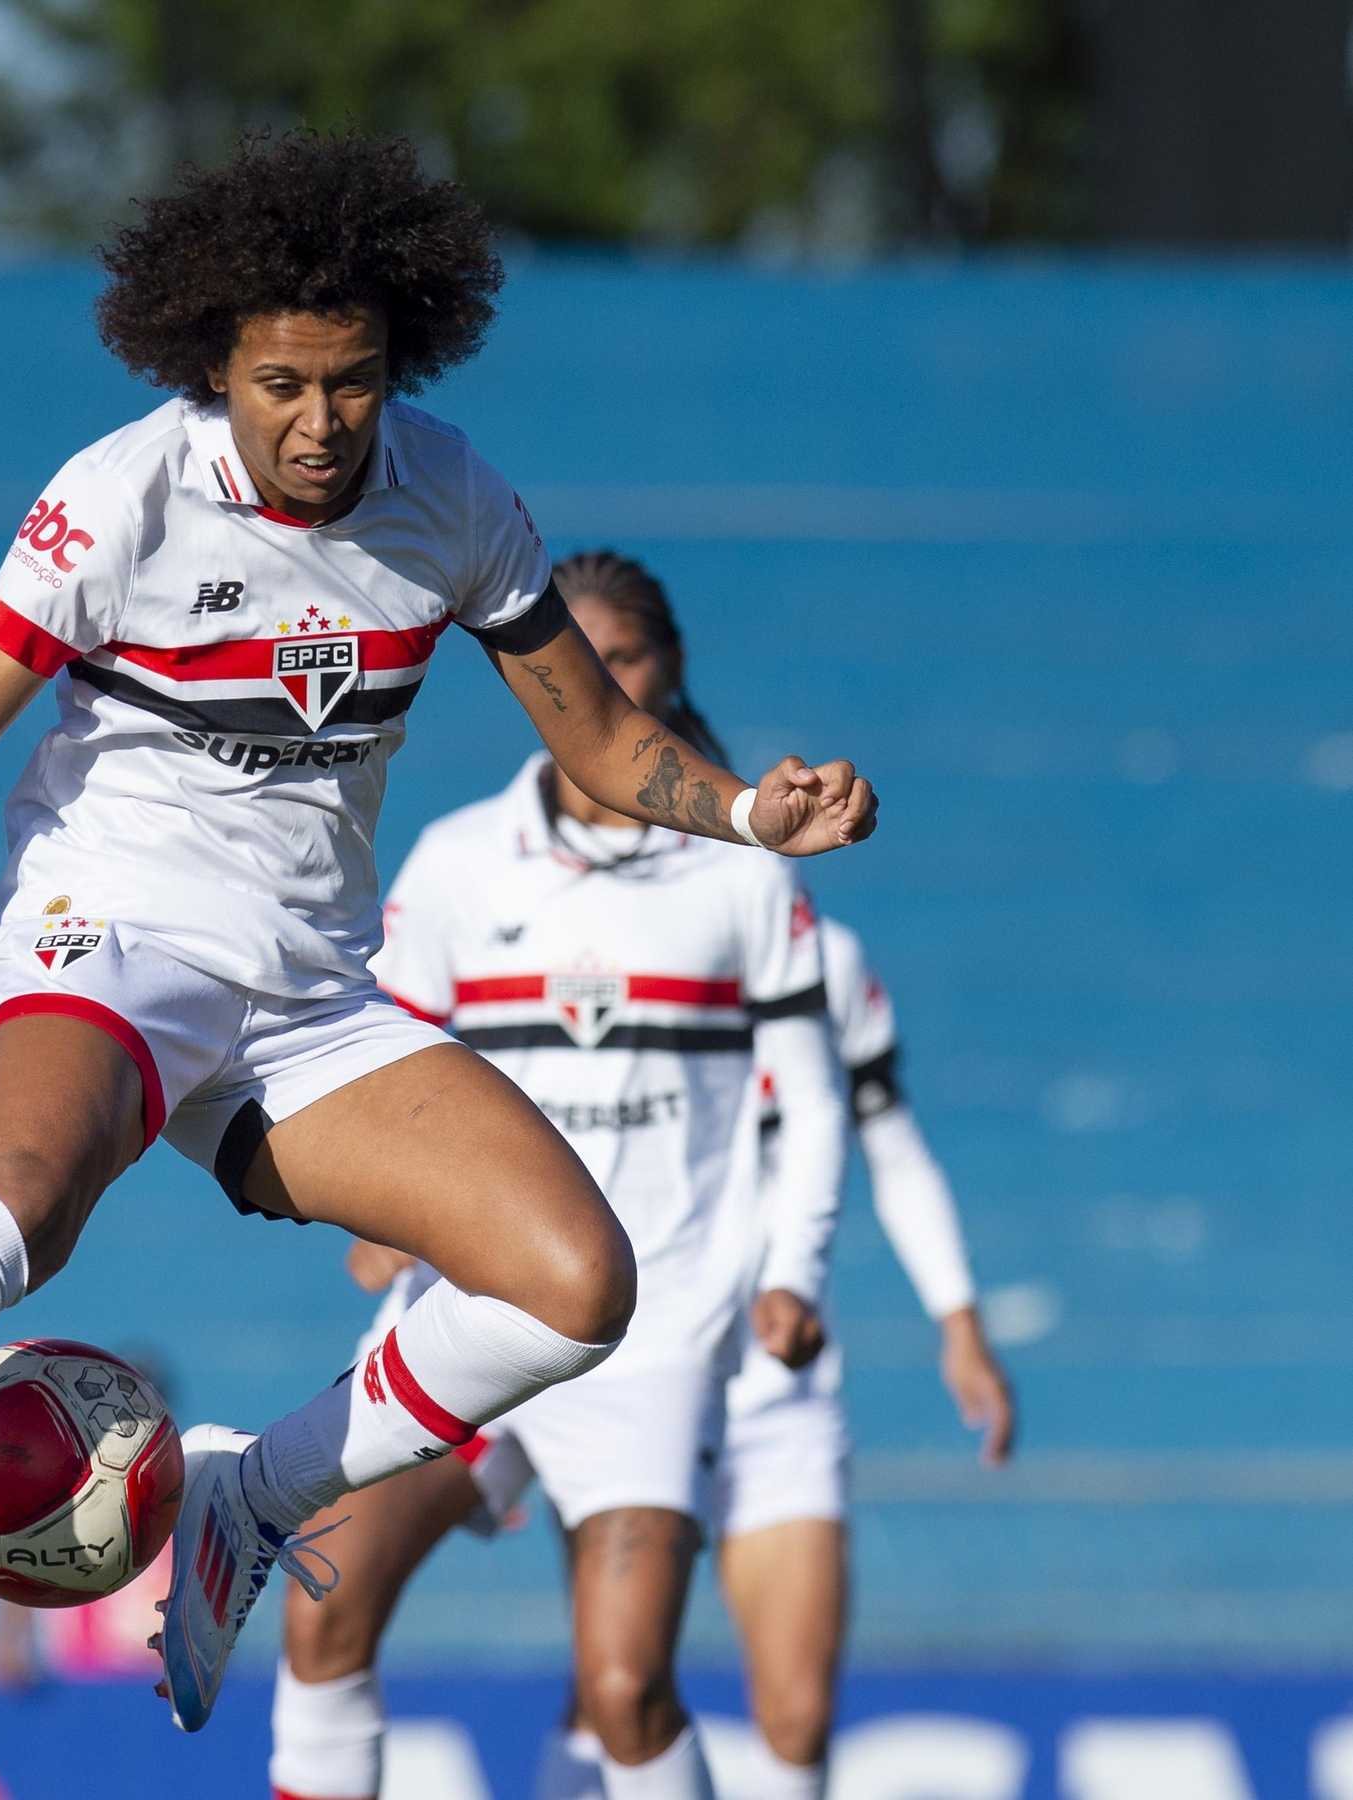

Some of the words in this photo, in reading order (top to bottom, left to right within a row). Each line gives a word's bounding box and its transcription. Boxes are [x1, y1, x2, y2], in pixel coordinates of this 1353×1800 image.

[19, 499, 95, 573] abc
[10, 546, 63, 589] onstrução
[281, 645, 349, 668] SPFC
[37, 934, 99, 949] SPFC
